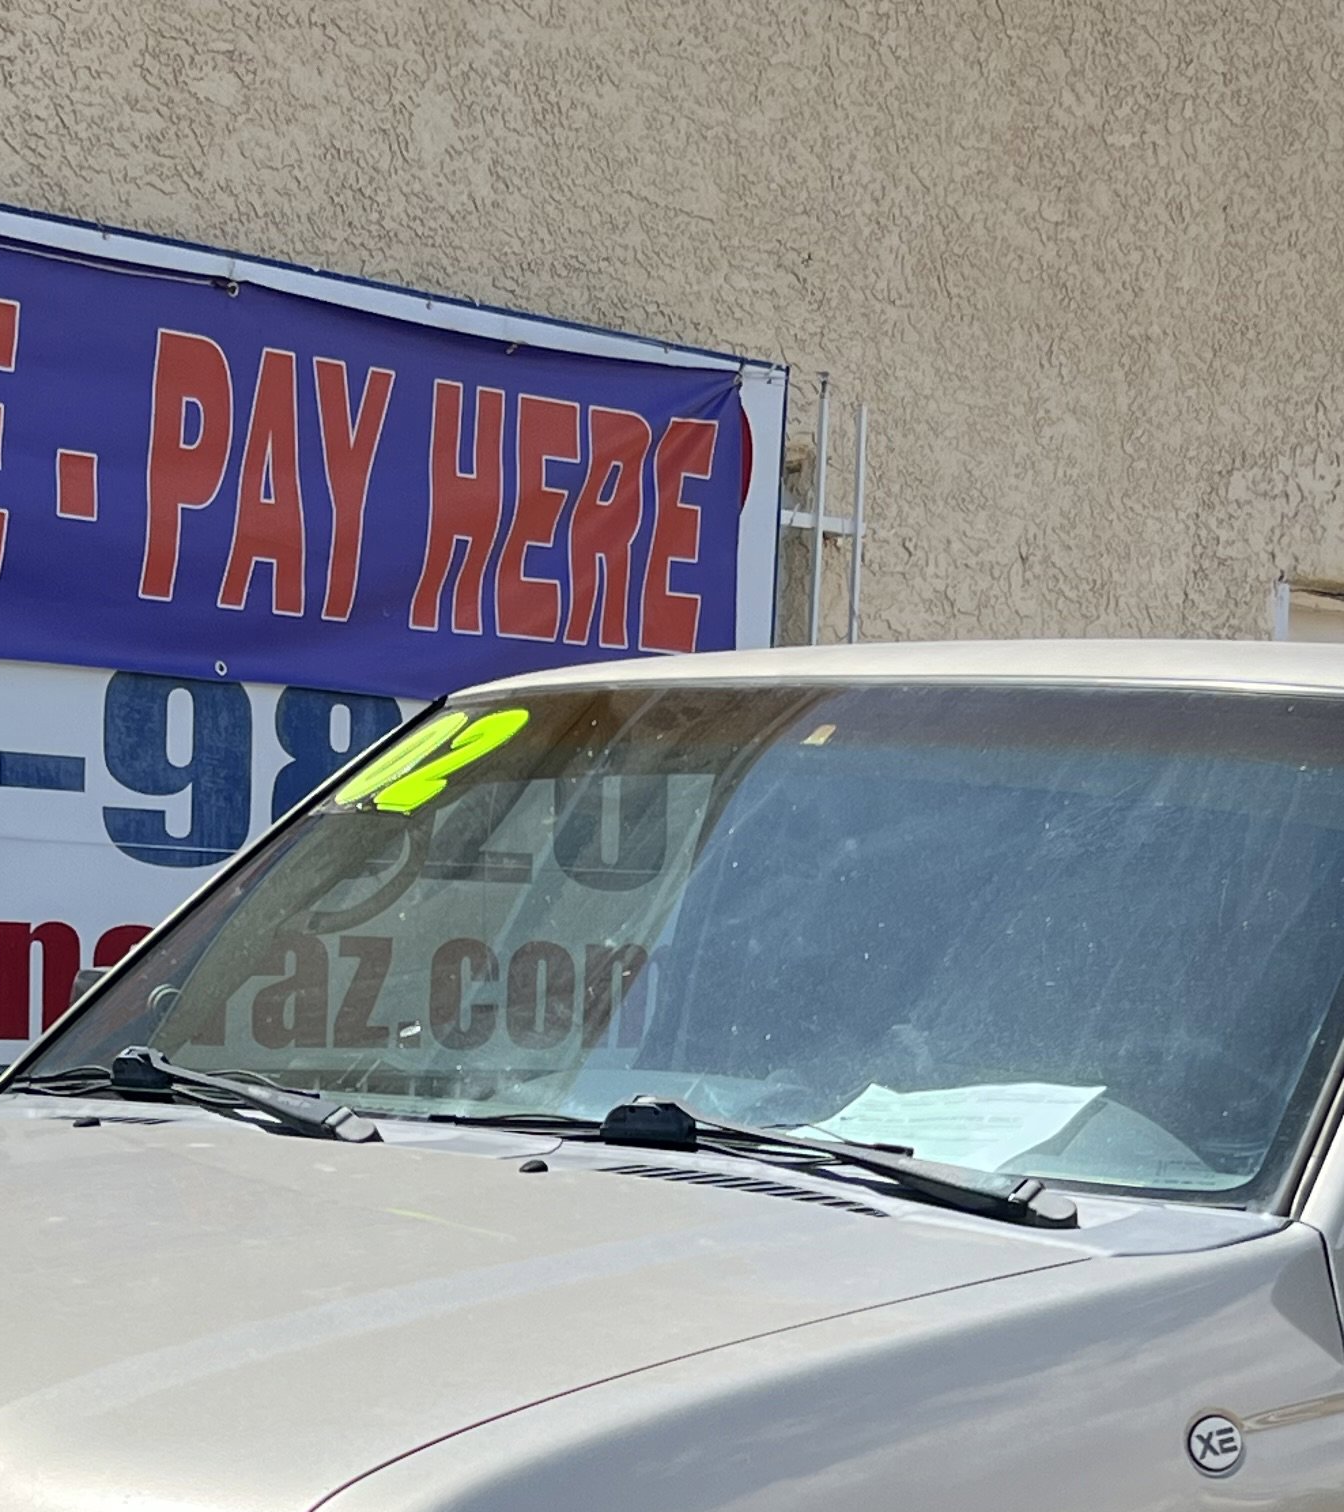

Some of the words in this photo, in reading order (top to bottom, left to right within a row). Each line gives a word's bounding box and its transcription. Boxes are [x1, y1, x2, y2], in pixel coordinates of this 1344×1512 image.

[138, 327, 396, 622] PAY
[409, 377, 719, 654] HERE
[1195, 1427, 1238, 1461] XE
